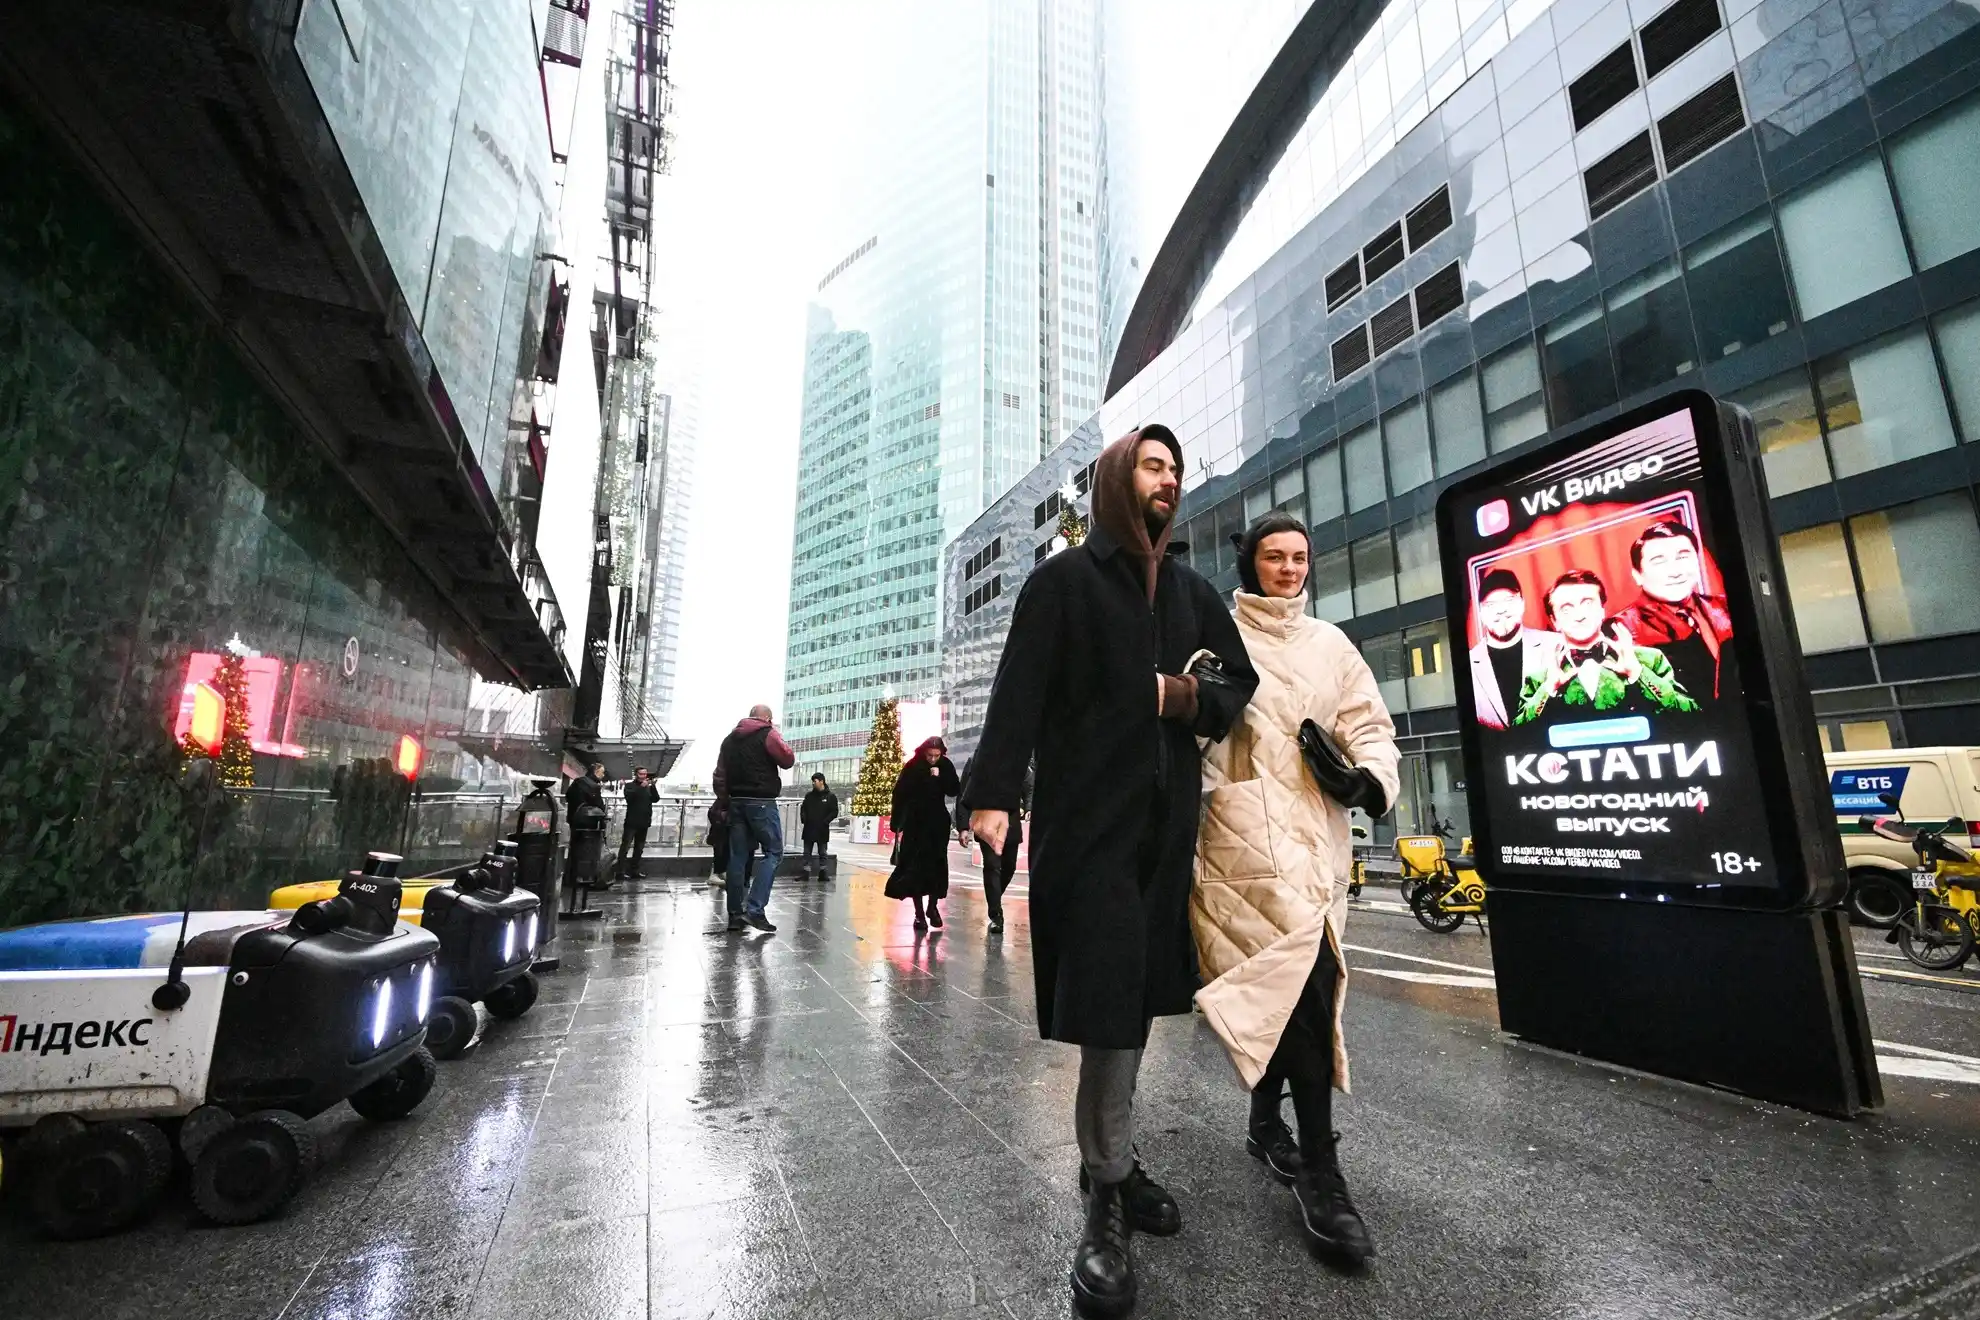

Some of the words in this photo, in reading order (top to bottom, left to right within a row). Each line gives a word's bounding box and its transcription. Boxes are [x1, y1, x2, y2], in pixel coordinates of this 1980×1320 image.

[1520, 485, 1561, 516] VK
[1564, 454, 1664, 502] Видео
[1505, 740, 1722, 785] КСТАТИ
[1857, 776, 1892, 790] ВТБ
[1711, 851, 1762, 874] 18+
